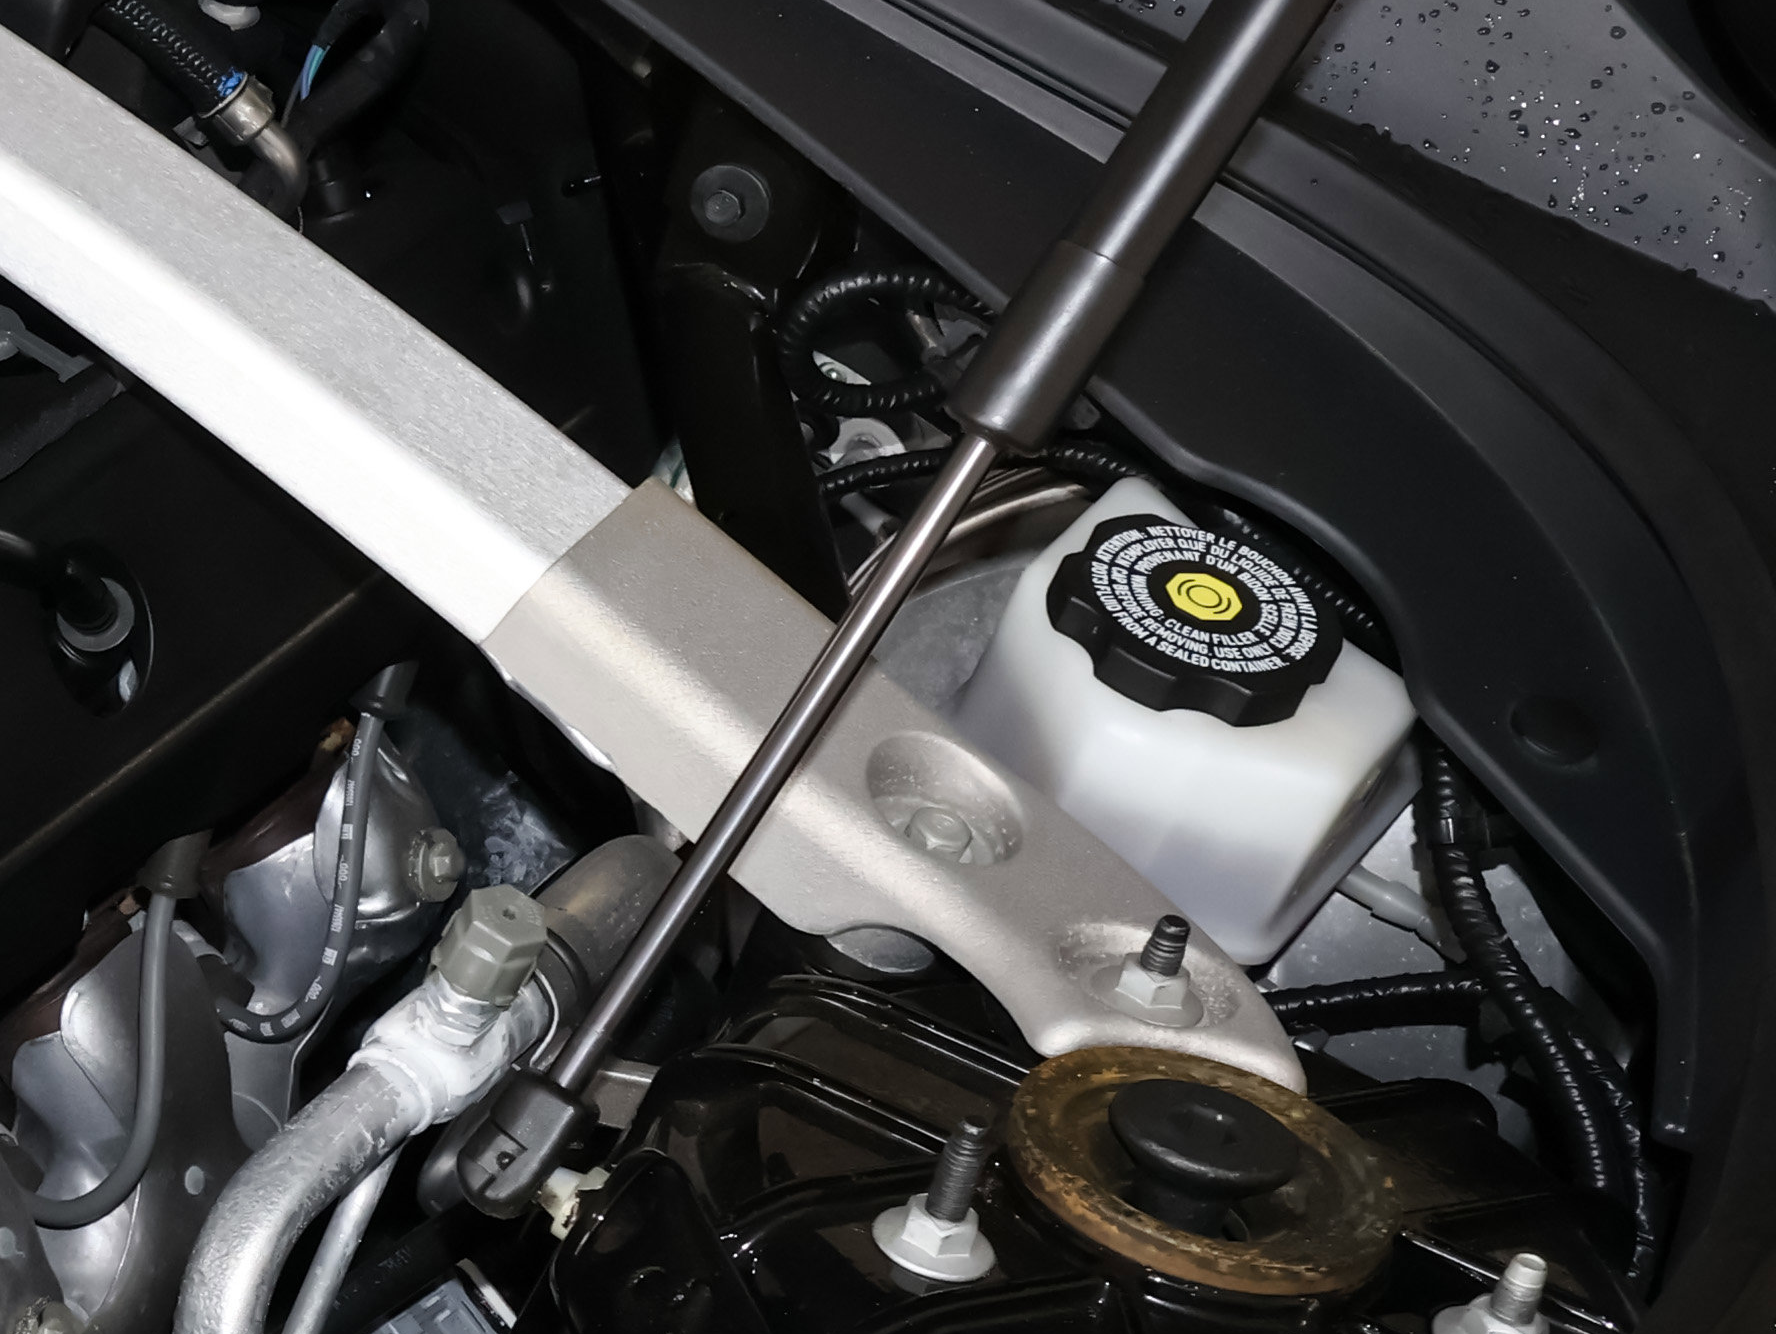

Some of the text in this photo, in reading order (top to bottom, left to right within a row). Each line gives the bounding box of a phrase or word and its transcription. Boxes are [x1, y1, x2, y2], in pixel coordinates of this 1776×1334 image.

[1095, 529, 1148, 564] ATTENTION:
[1145, 525, 1216, 544] NETTOYER
[1176, 538, 1207, 553] QUE
[1218, 536, 1237, 551] LE
[1114, 537, 1178, 568] N'EMPLOYER
[1209, 544, 1231, 559] DU
[1237, 545, 1297, 586] BOUCHON
[1133, 549, 1201, 575] PROVENANT
[1205, 554, 1240, 575] D'UN
[1236, 571, 1274, 601] BIDON
[1230, 553, 1280, 587] LIQUIDE
[1270, 587, 1292, 600] DE
[1286, 586, 1317, 617] AVANT
[1110, 566, 1275, 660] CAP BEFORE REMOVING. USE ONLY
[1130, 574, 1260, 646] WARNING: CLEAN FILLER
[1278, 601, 1299, 630] FREIN
[1300, 615, 1318, 630] LA
[1093, 584, 1123, 612] FLUID
[1112, 611, 1150, 639] FROM
[1143, 635, 1158, 647] A
[1156, 640, 1210, 668] SEALED
[1210, 655, 1290, 673] CONTAINER.
